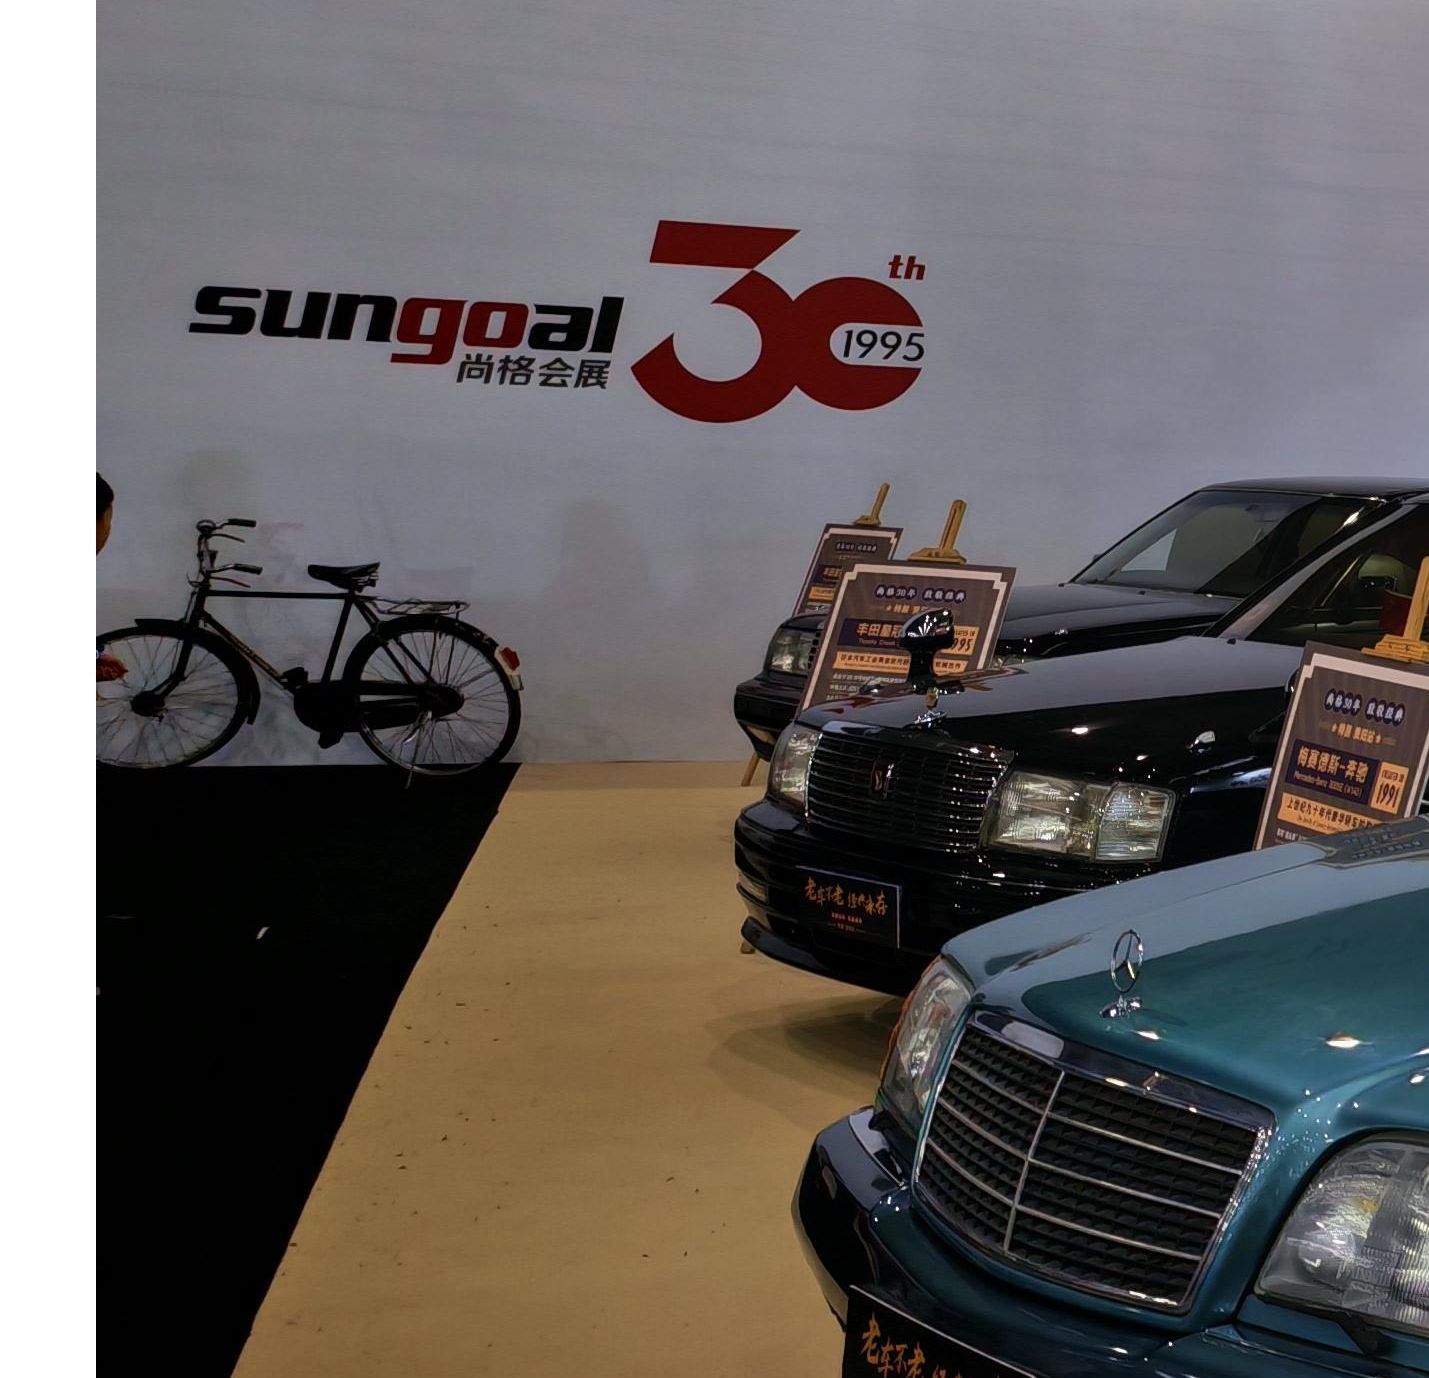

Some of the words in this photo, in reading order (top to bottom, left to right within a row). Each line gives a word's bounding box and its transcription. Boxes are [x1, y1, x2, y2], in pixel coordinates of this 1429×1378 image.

[188, 285, 626, 366] sungoal
[629, 218, 925, 424] 30
[887, 254, 926, 281] th
[841, 329, 925, 363] 1995
[455, 352, 613, 390] 尚格会展
[951, 637, 972, 652] 995
[1375, 781, 1401, 808] 1991
